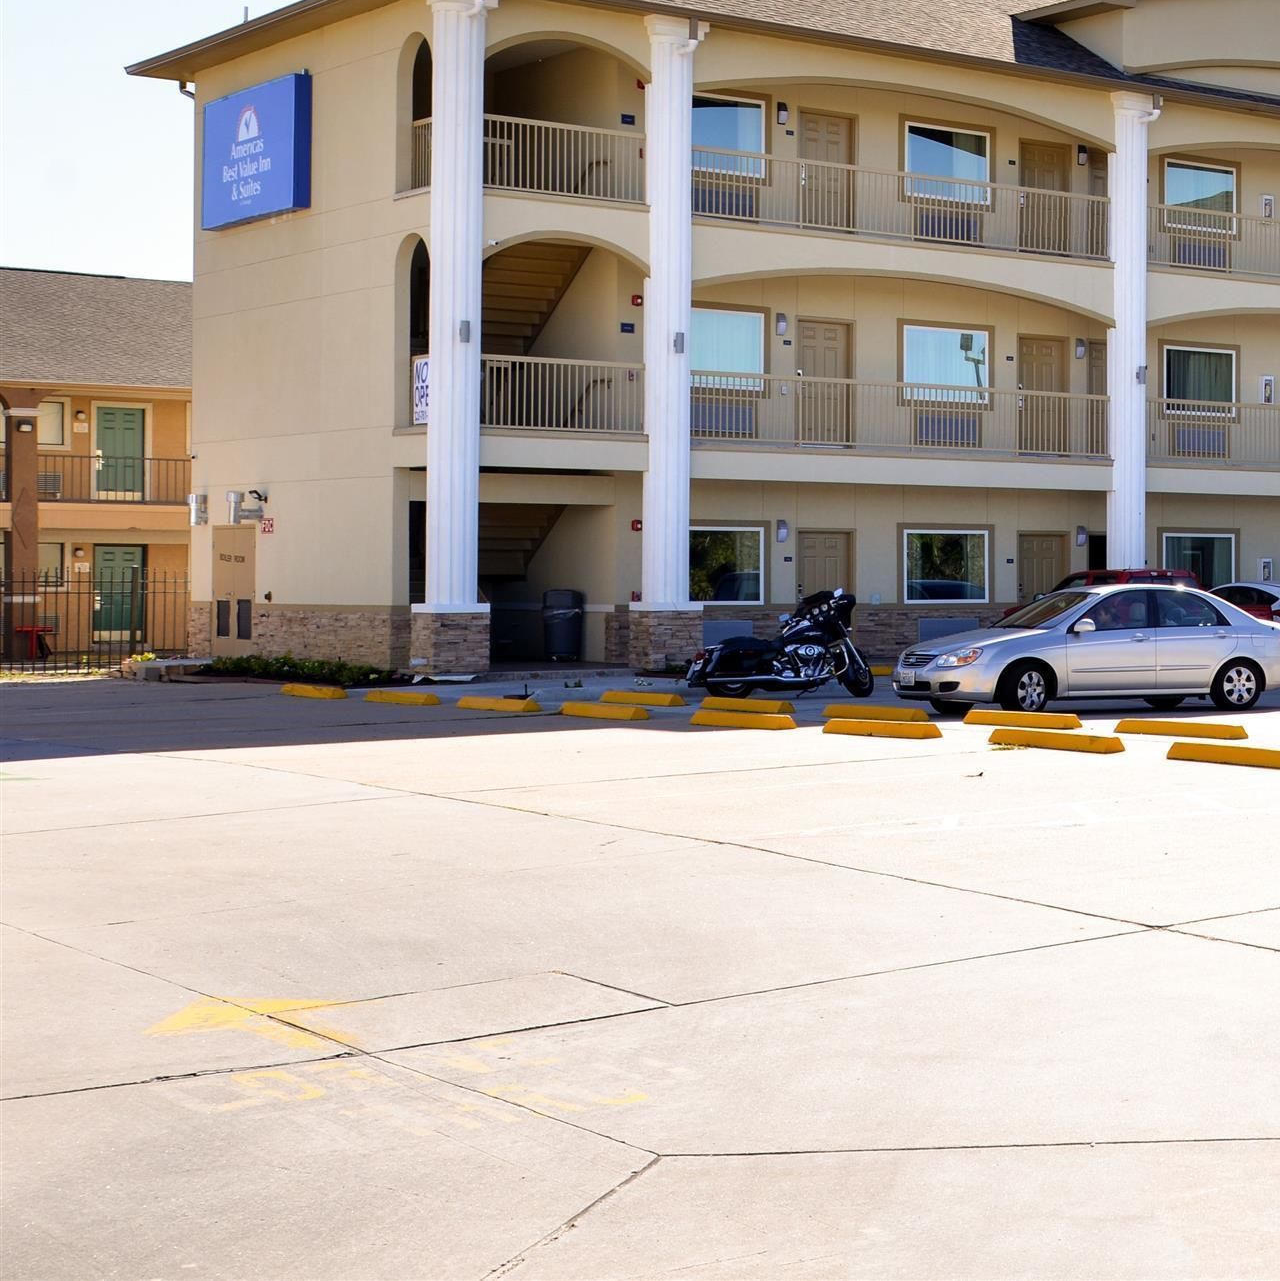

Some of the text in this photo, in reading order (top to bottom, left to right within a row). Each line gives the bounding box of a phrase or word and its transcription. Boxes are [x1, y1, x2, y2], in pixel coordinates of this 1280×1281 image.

[230, 138, 264, 160] Americas
[222, 155, 271, 183] Best Value Inn
[239, 179, 262, 199] Suites
[415, 361, 429, 384] NO
[415, 385, 429, 408] OPE
